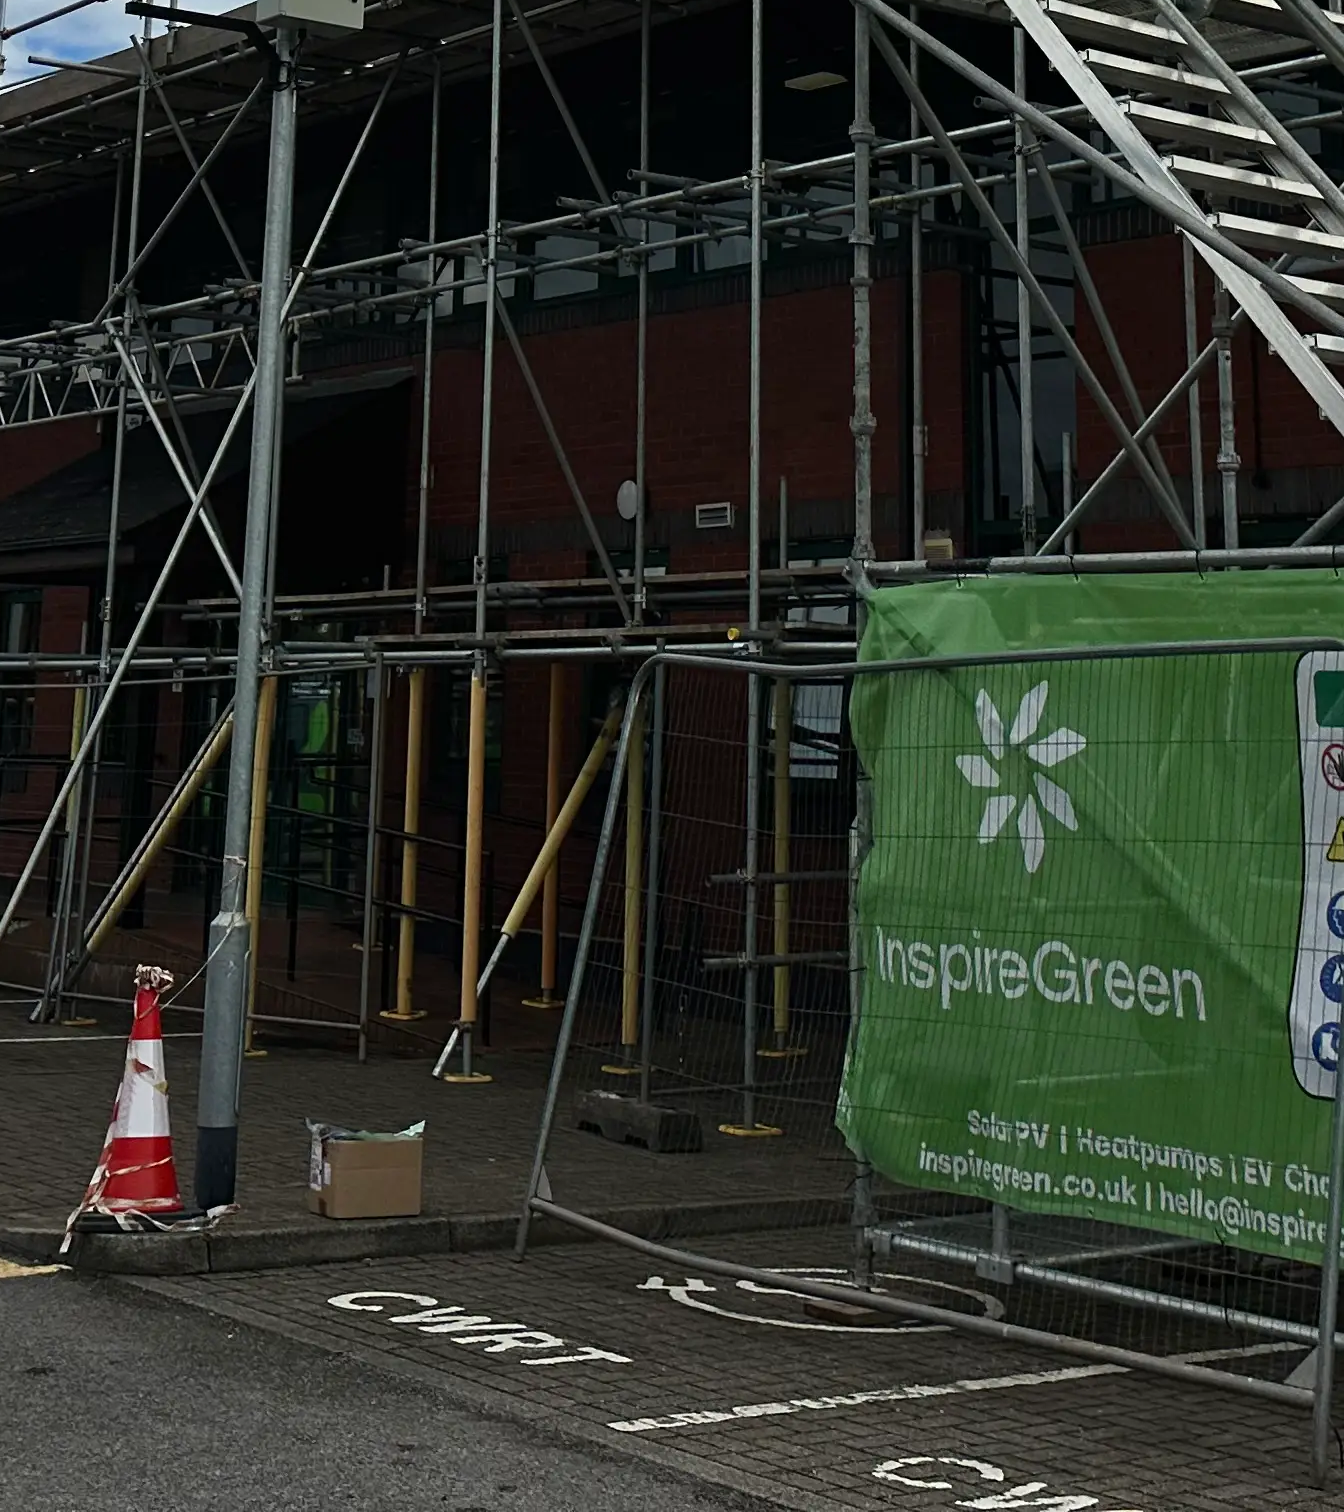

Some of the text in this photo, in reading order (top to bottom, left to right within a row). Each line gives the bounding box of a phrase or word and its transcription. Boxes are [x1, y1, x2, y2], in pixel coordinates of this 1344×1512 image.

[875, 925, 1207, 1022] InspireGreen
[919, 1142, 1137, 1206] inspiregreen.co.uk
[1015, 1119, 1050, 1149] PV
[1077, 1127, 1223, 1181] Heatpumps
[1242, 1156, 1272, 1187] EV
[327, 1291, 634, 1365] CWRT
